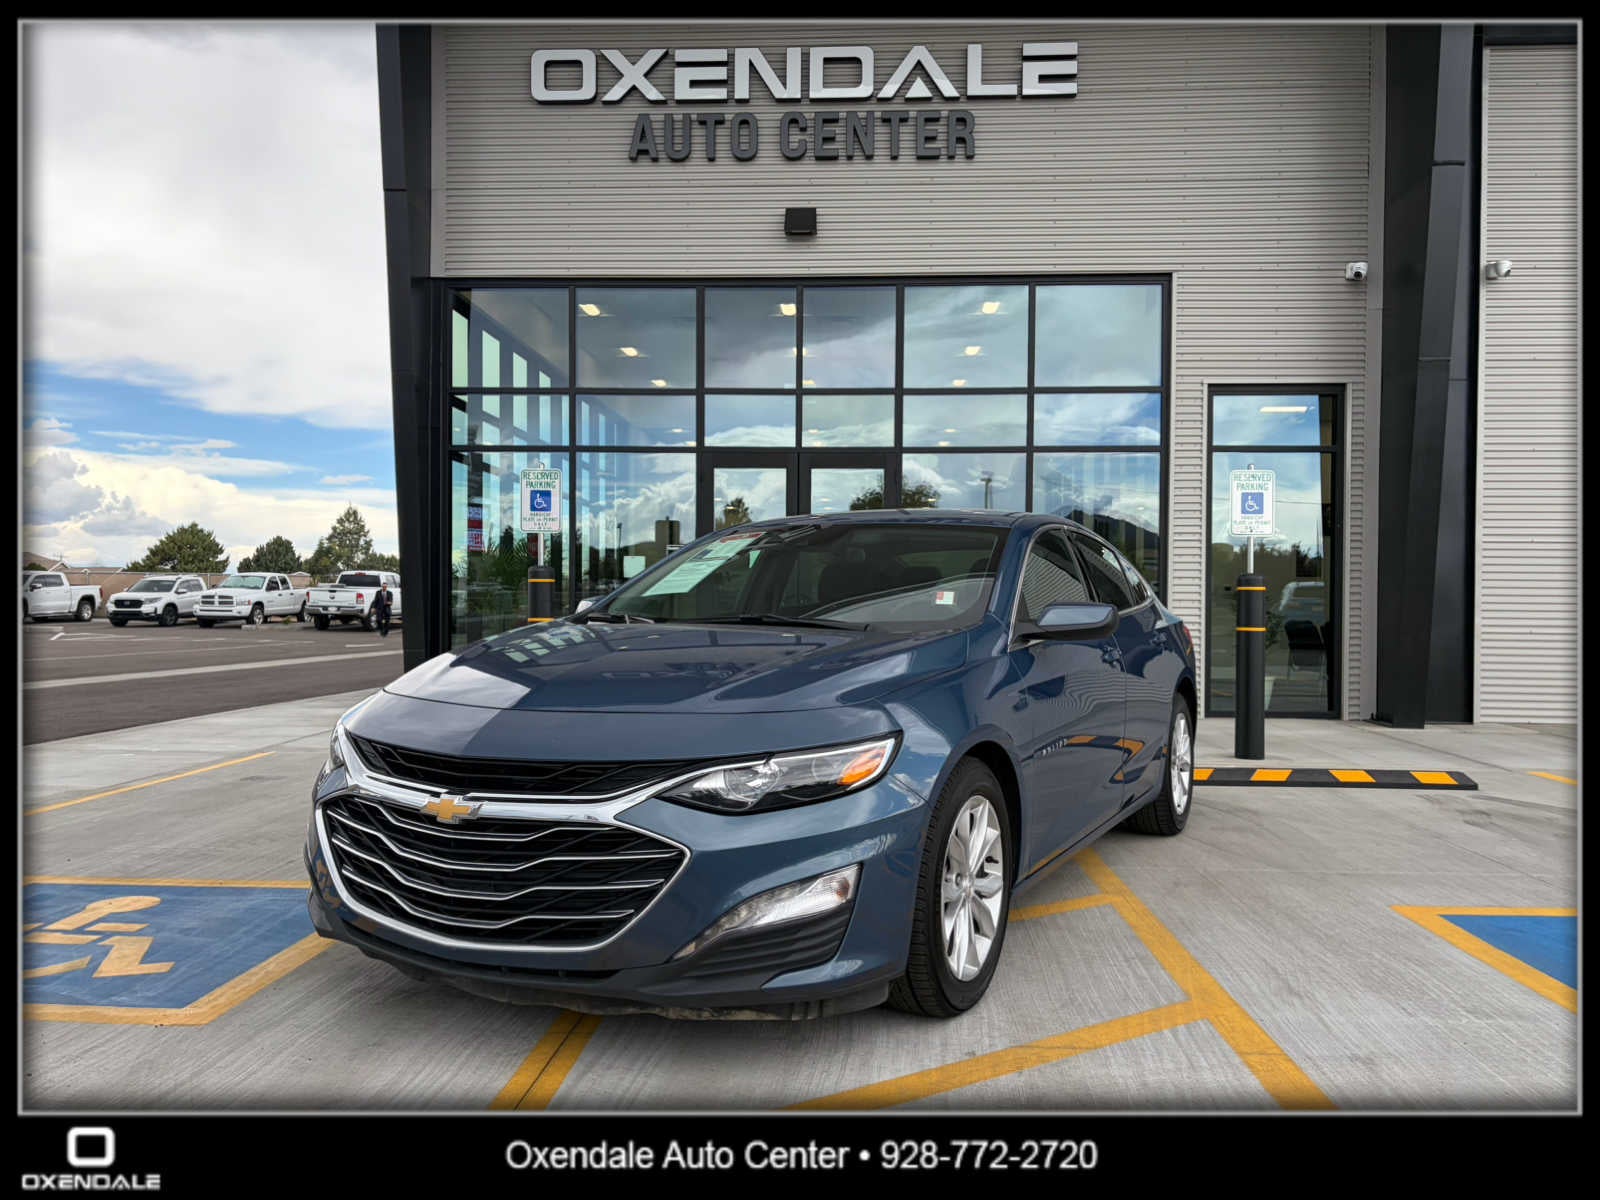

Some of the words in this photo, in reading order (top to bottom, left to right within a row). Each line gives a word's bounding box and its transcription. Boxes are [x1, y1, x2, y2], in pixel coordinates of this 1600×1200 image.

[530, 41, 1079, 104] OXENDALE
[628, 111, 758, 162] AUTO
[780, 109, 977, 161] CENTER
[522, 471, 559, 480] RESERVED
[1233, 472, 1272, 482] RESERVED
[525, 480, 557, 489] PARKING
[1236, 482, 1270, 491] PARKING
